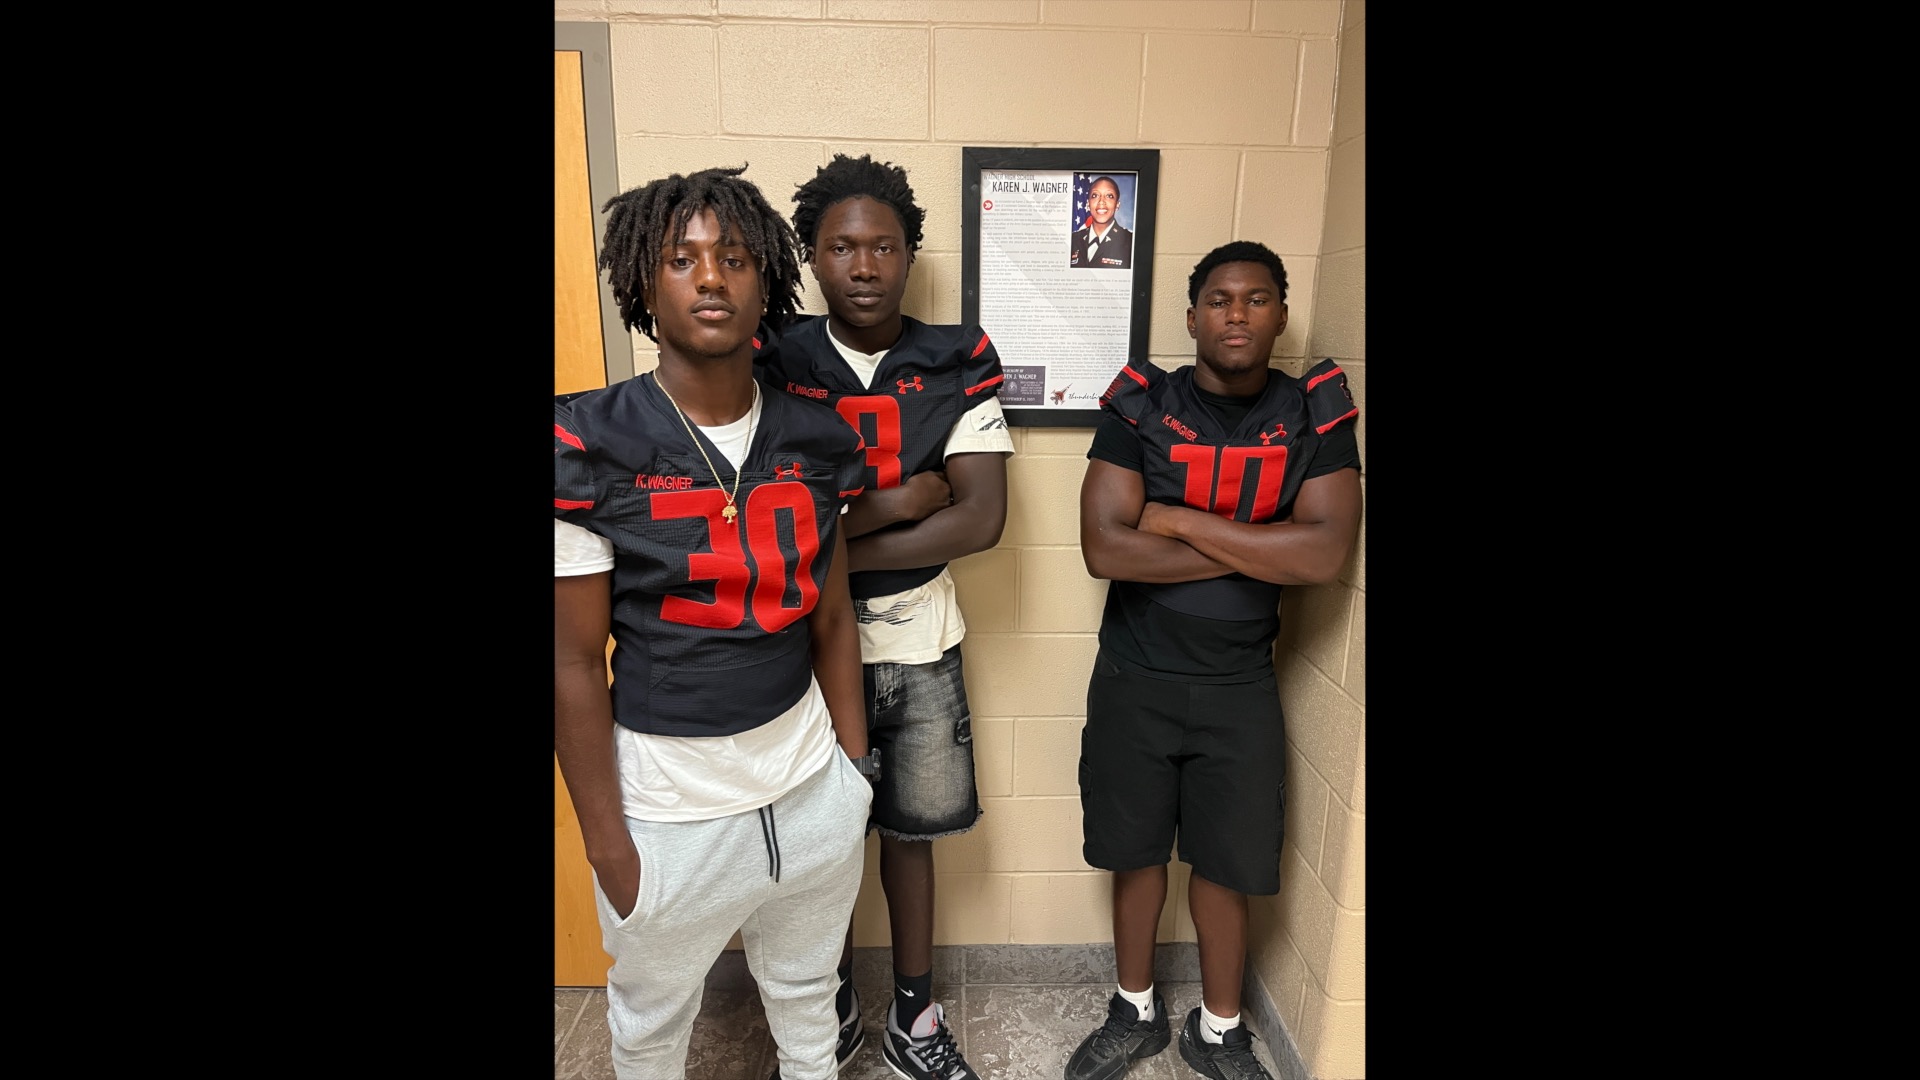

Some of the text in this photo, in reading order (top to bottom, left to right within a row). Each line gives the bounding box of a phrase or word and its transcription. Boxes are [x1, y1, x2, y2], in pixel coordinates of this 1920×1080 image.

[992, 181, 1068, 194] KAREN J. WAGNER
[1170, 444, 1288, 523] 10
[650, 481, 820, 633] 30
